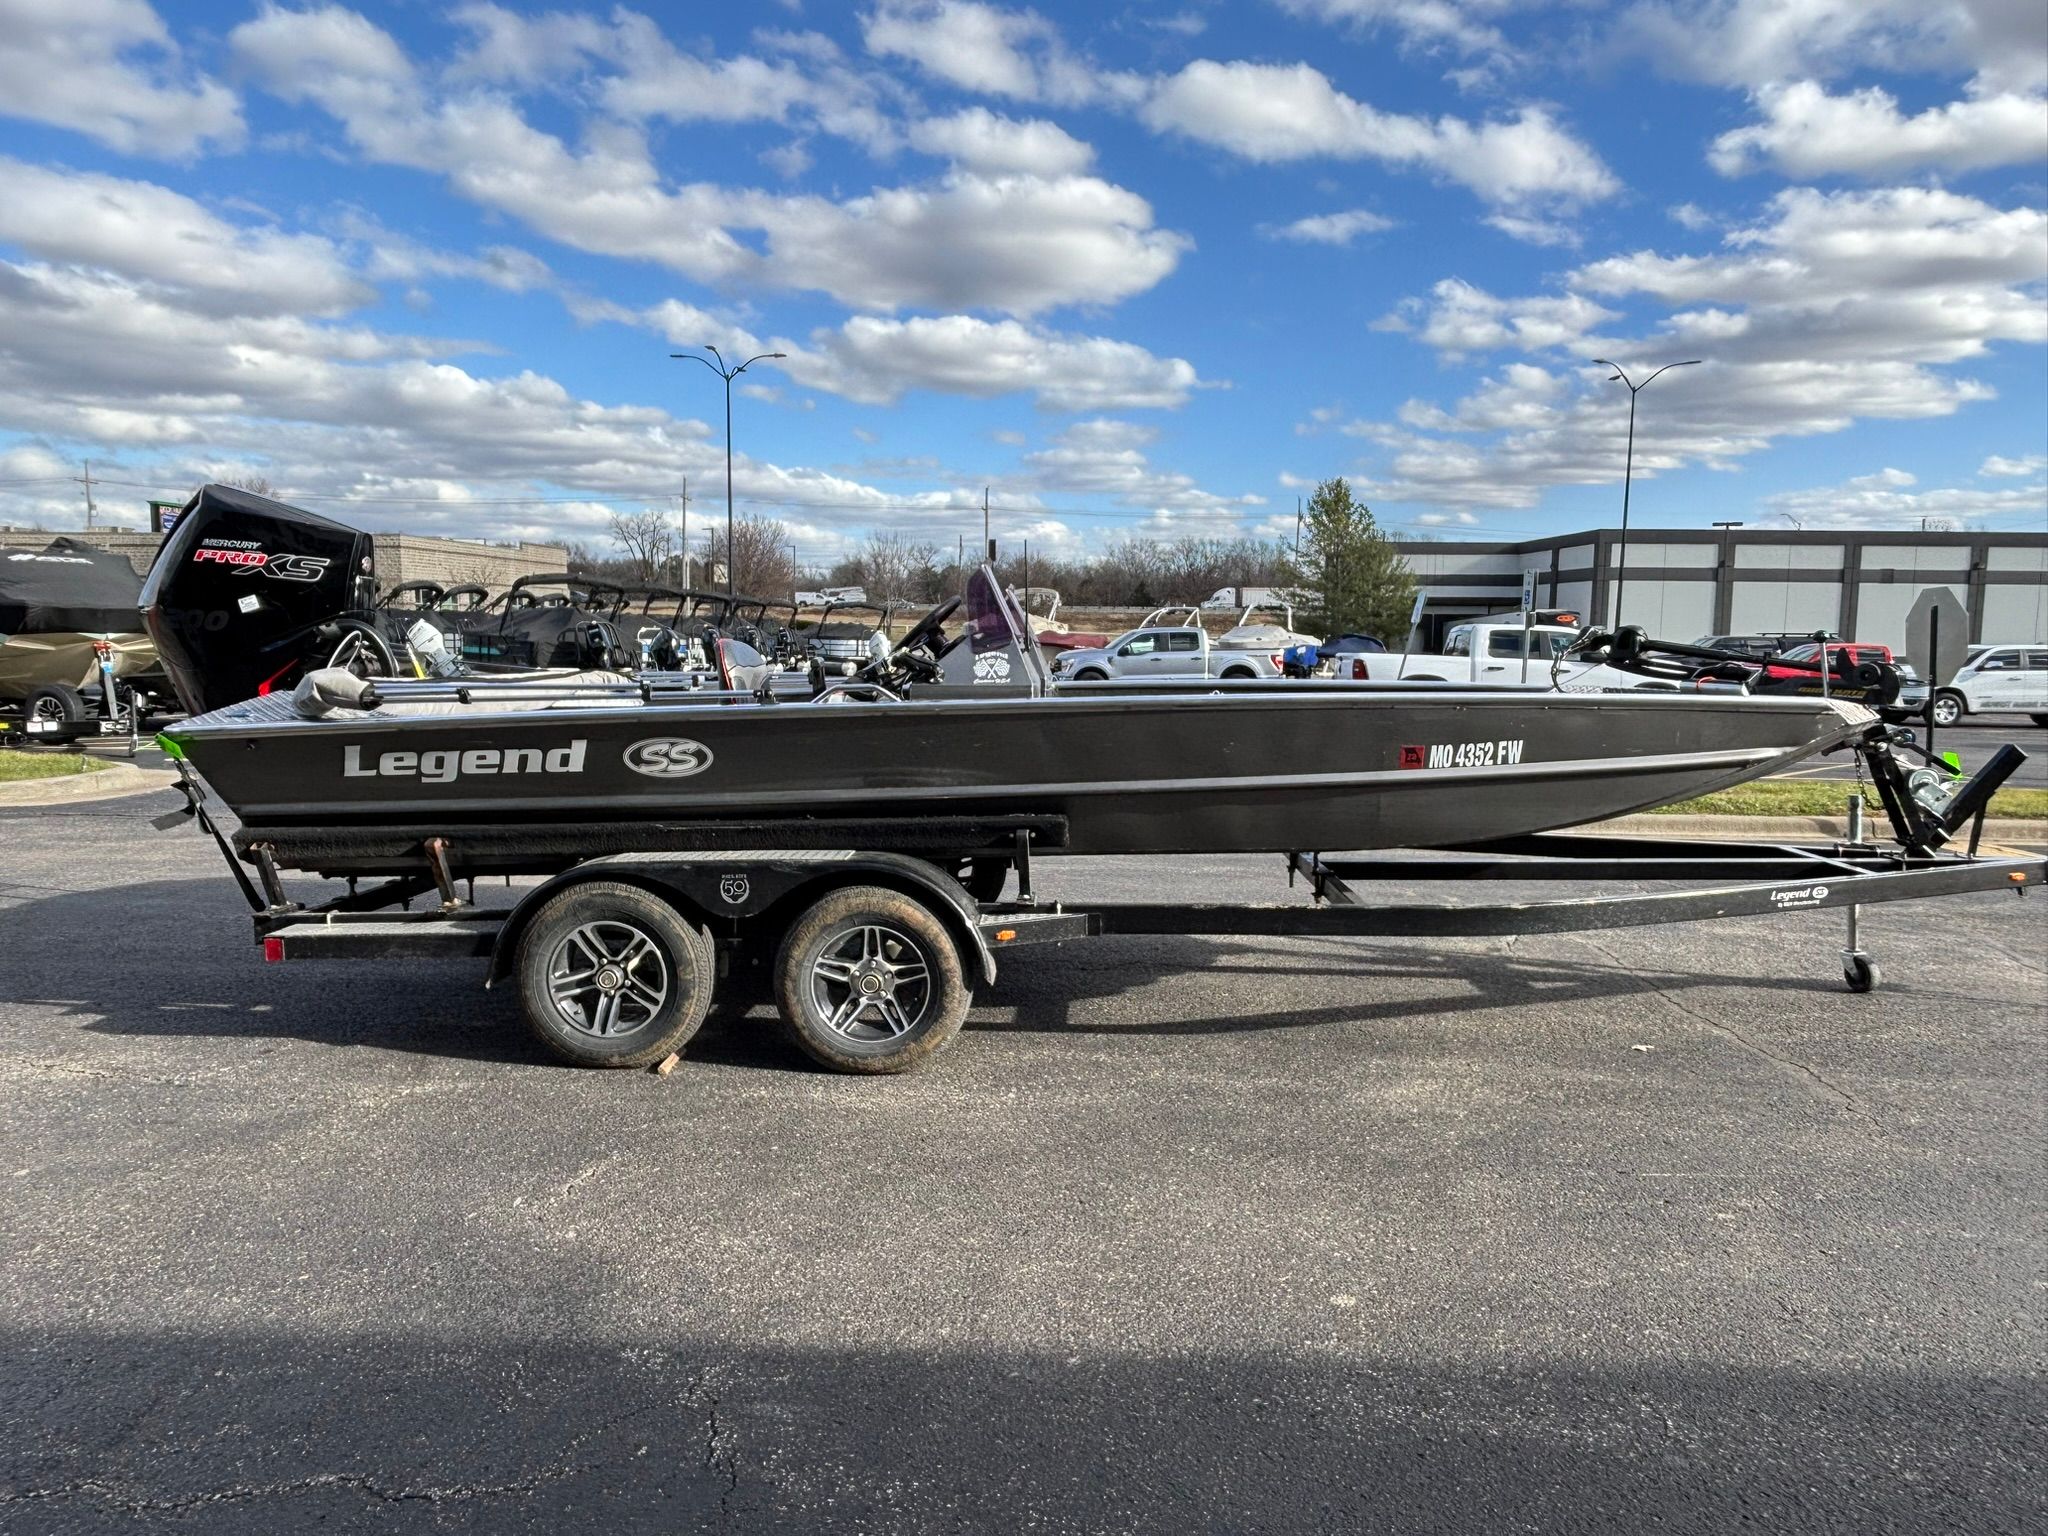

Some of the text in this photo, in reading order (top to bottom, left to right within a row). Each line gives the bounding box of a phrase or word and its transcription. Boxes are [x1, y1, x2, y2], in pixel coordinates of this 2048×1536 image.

[201, 538, 262, 550] MERCURY
[194, 549, 269, 567] PRO
[344, 739, 587, 783] Legend
[638, 743, 701, 772] SS
[1428, 740, 1524, 769] MO 4352 FW
[724, 879, 745, 896] 50
[1770, 888, 1810, 901] Legend
